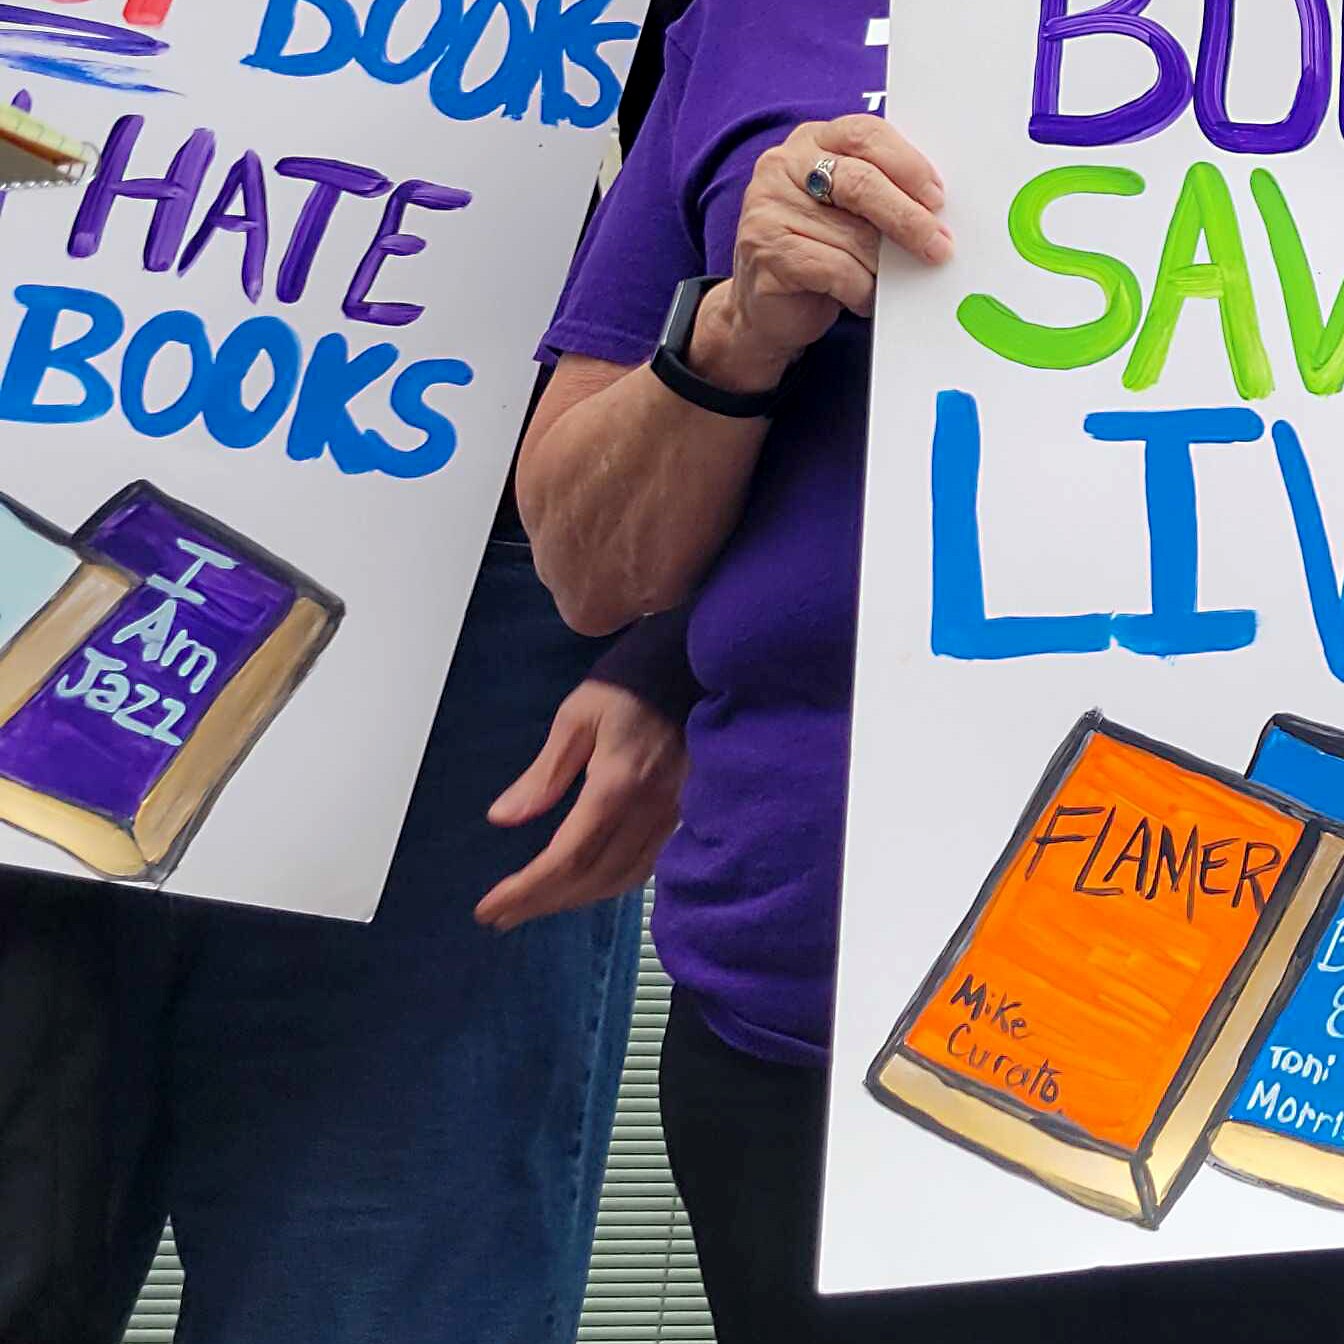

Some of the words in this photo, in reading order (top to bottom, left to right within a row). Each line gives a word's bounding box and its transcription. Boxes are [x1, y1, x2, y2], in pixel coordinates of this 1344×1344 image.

[67, 113, 474, 327] HATE
[0, 284, 474, 478] BOOKS
[145, 538, 239, 606] I
[112, 600, 219, 694] Am
[55, 648, 185, 748] Jazz
[1024, 802, 1283, 928] FLAMER
[1269, 1044, 1332, 1085] Toni
